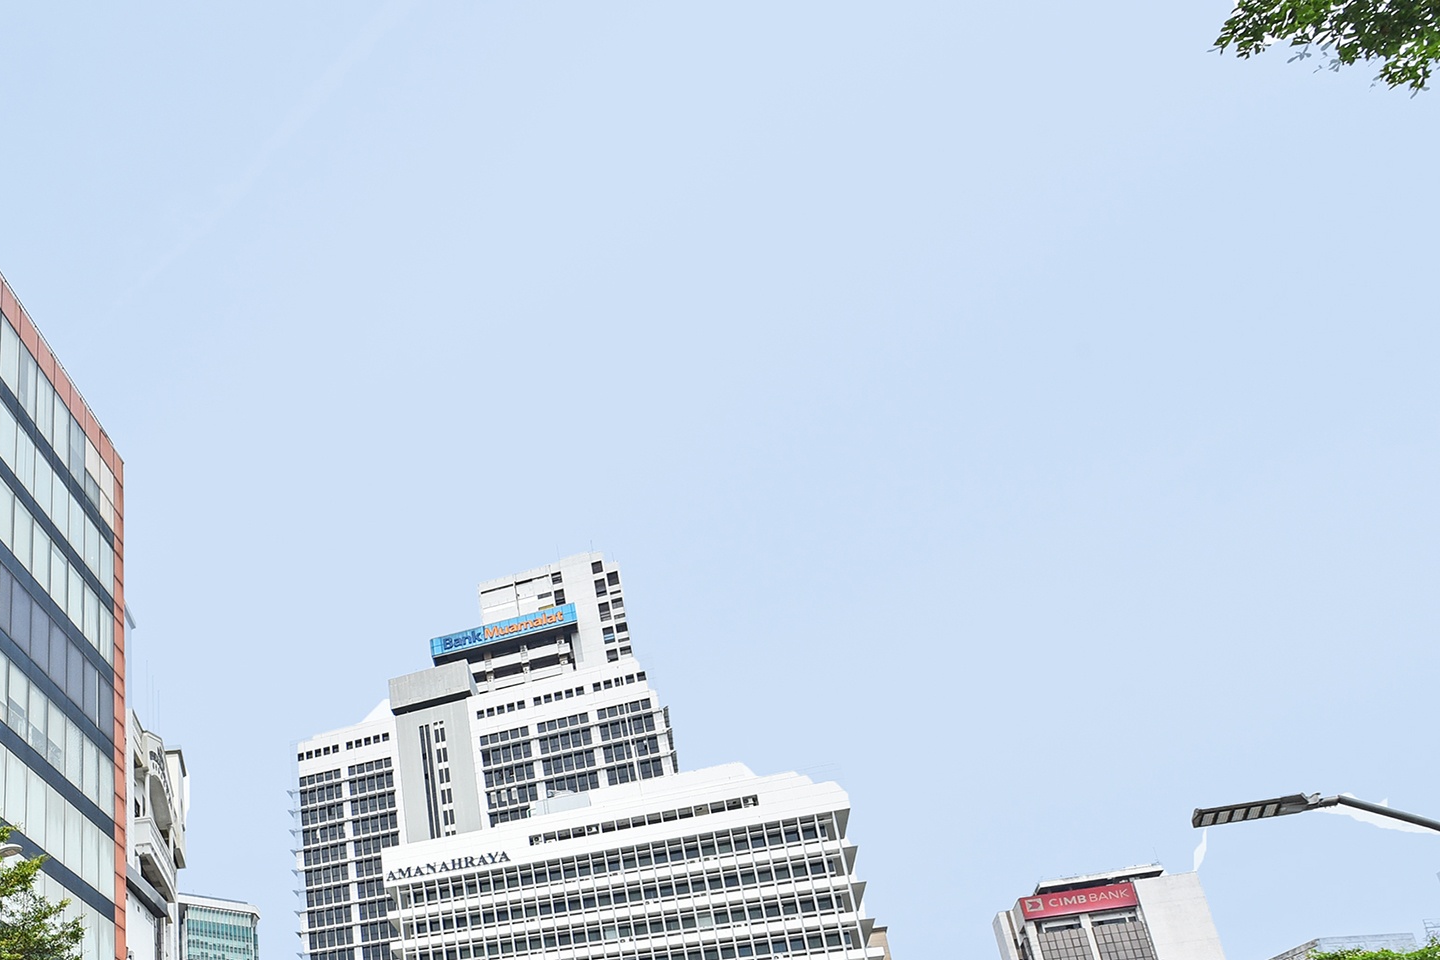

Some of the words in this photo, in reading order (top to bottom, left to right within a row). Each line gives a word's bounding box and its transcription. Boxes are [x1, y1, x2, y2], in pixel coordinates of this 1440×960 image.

[443, 630, 482, 650] Bank
[483, 610, 564, 639] Muamalat
[386, 850, 511, 881] AMANAHRAYA
[1048, 894, 1087, 908] CIMB
[1089, 888, 1130, 903] BANK
